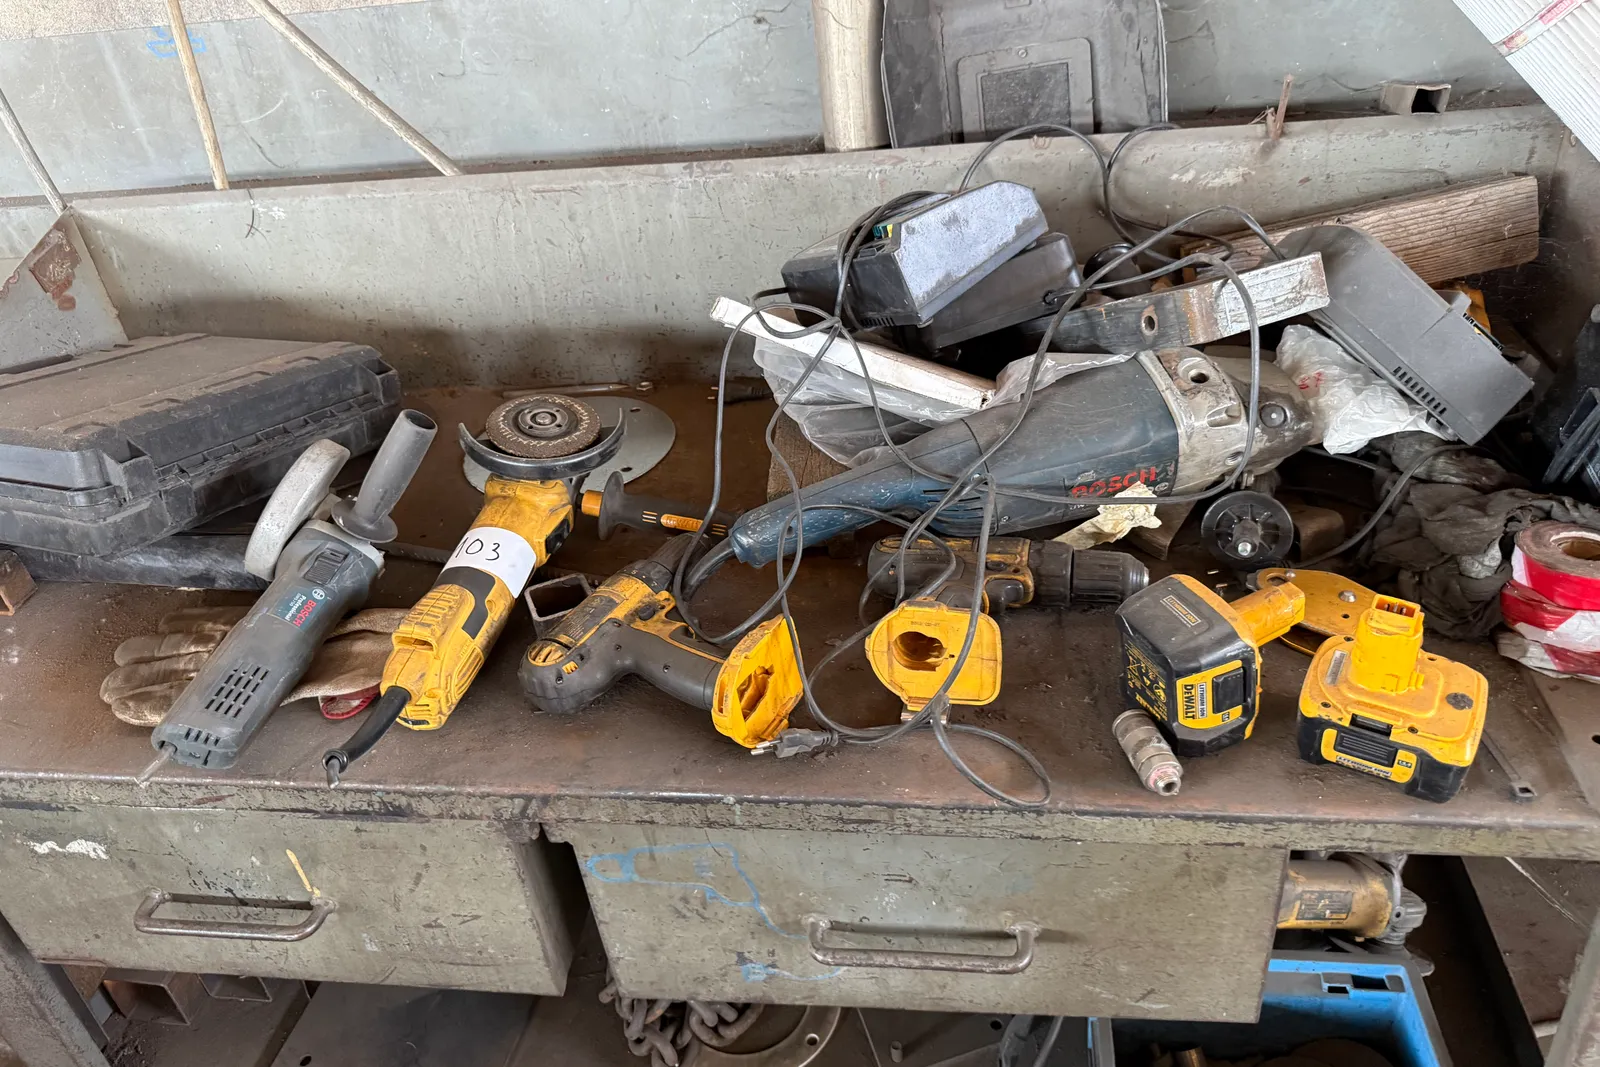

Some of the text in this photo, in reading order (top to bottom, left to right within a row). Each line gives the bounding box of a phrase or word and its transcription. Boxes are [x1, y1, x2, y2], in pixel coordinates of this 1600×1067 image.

[1072, 466, 1158, 499] BOSCH
[454, 537, 501, 561] 103
[293, 600, 316, 627] BOSCH
